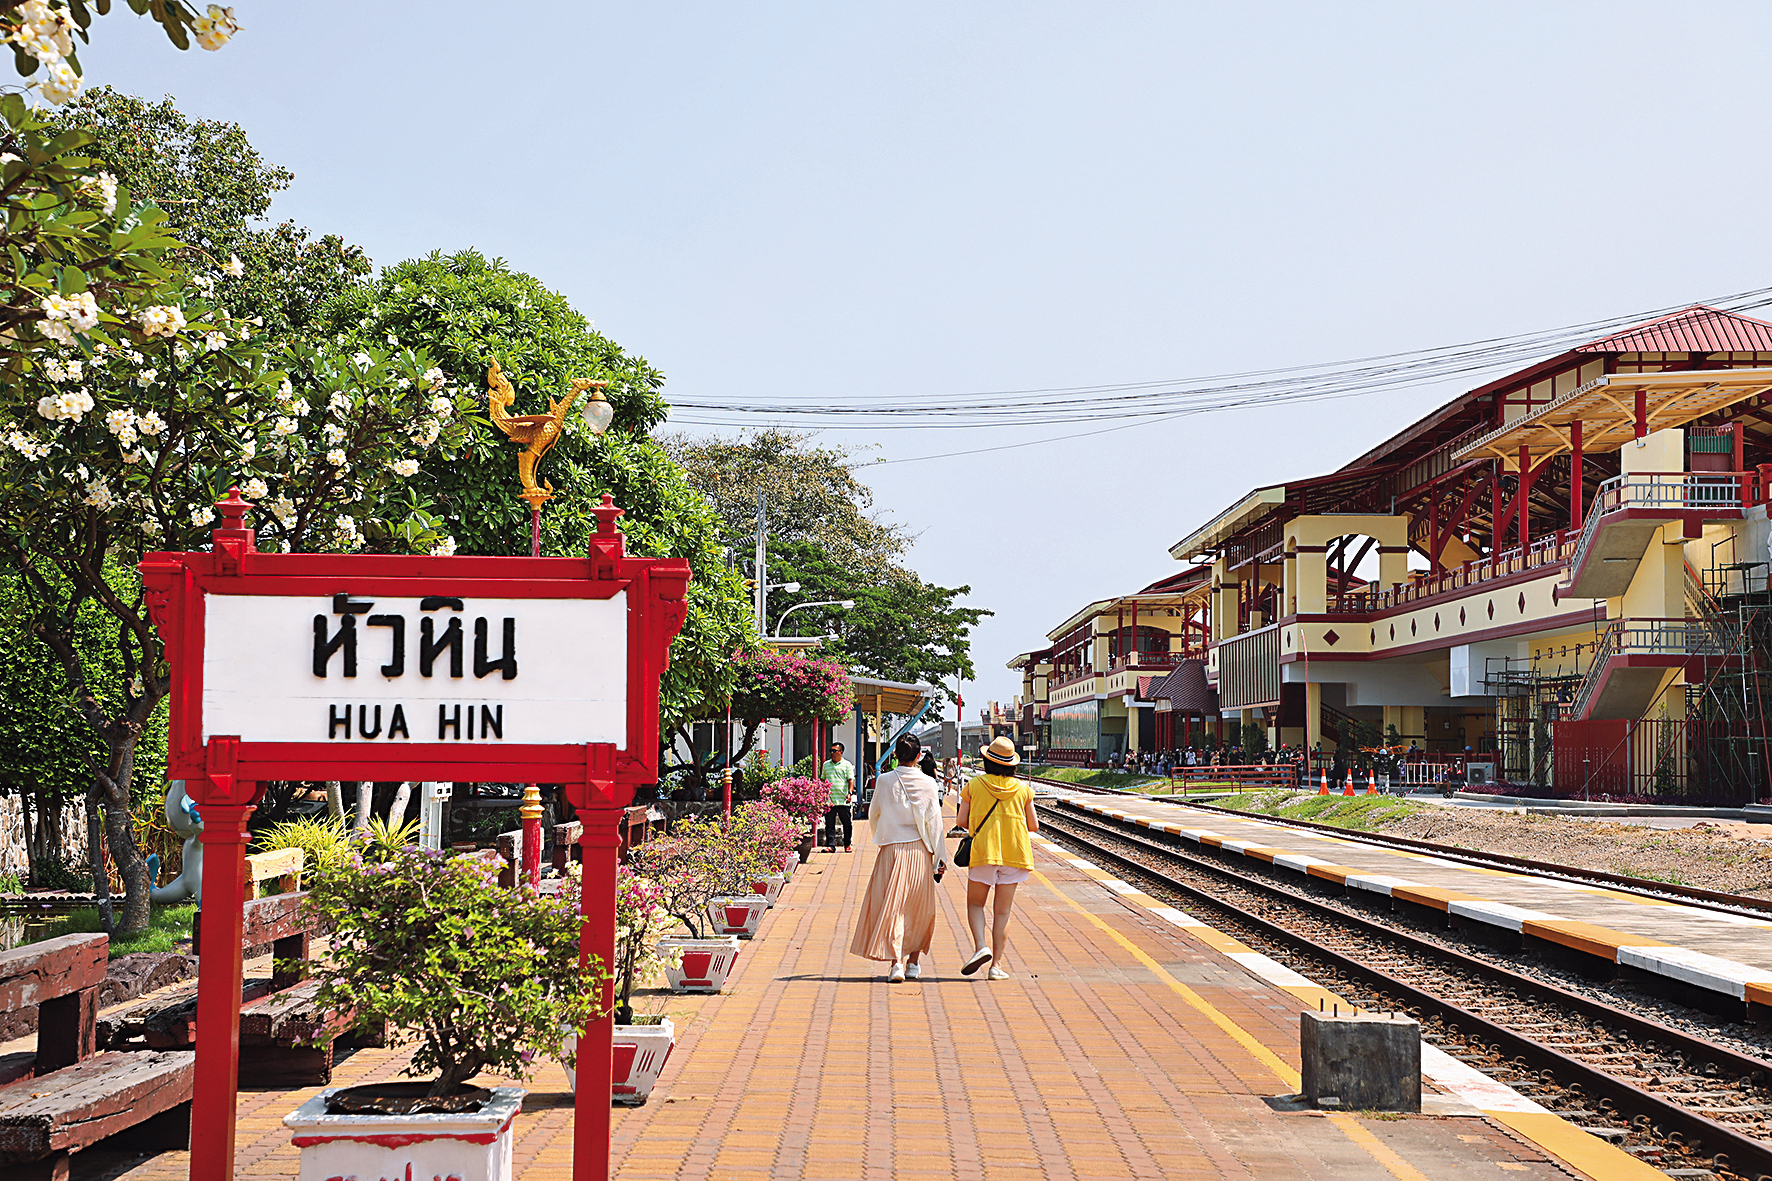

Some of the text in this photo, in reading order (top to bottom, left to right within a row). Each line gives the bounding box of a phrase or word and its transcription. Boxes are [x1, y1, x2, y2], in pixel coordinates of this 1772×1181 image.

[312, 593, 518, 681] หัวหิน
[328, 703, 503, 741] HUA HIN
